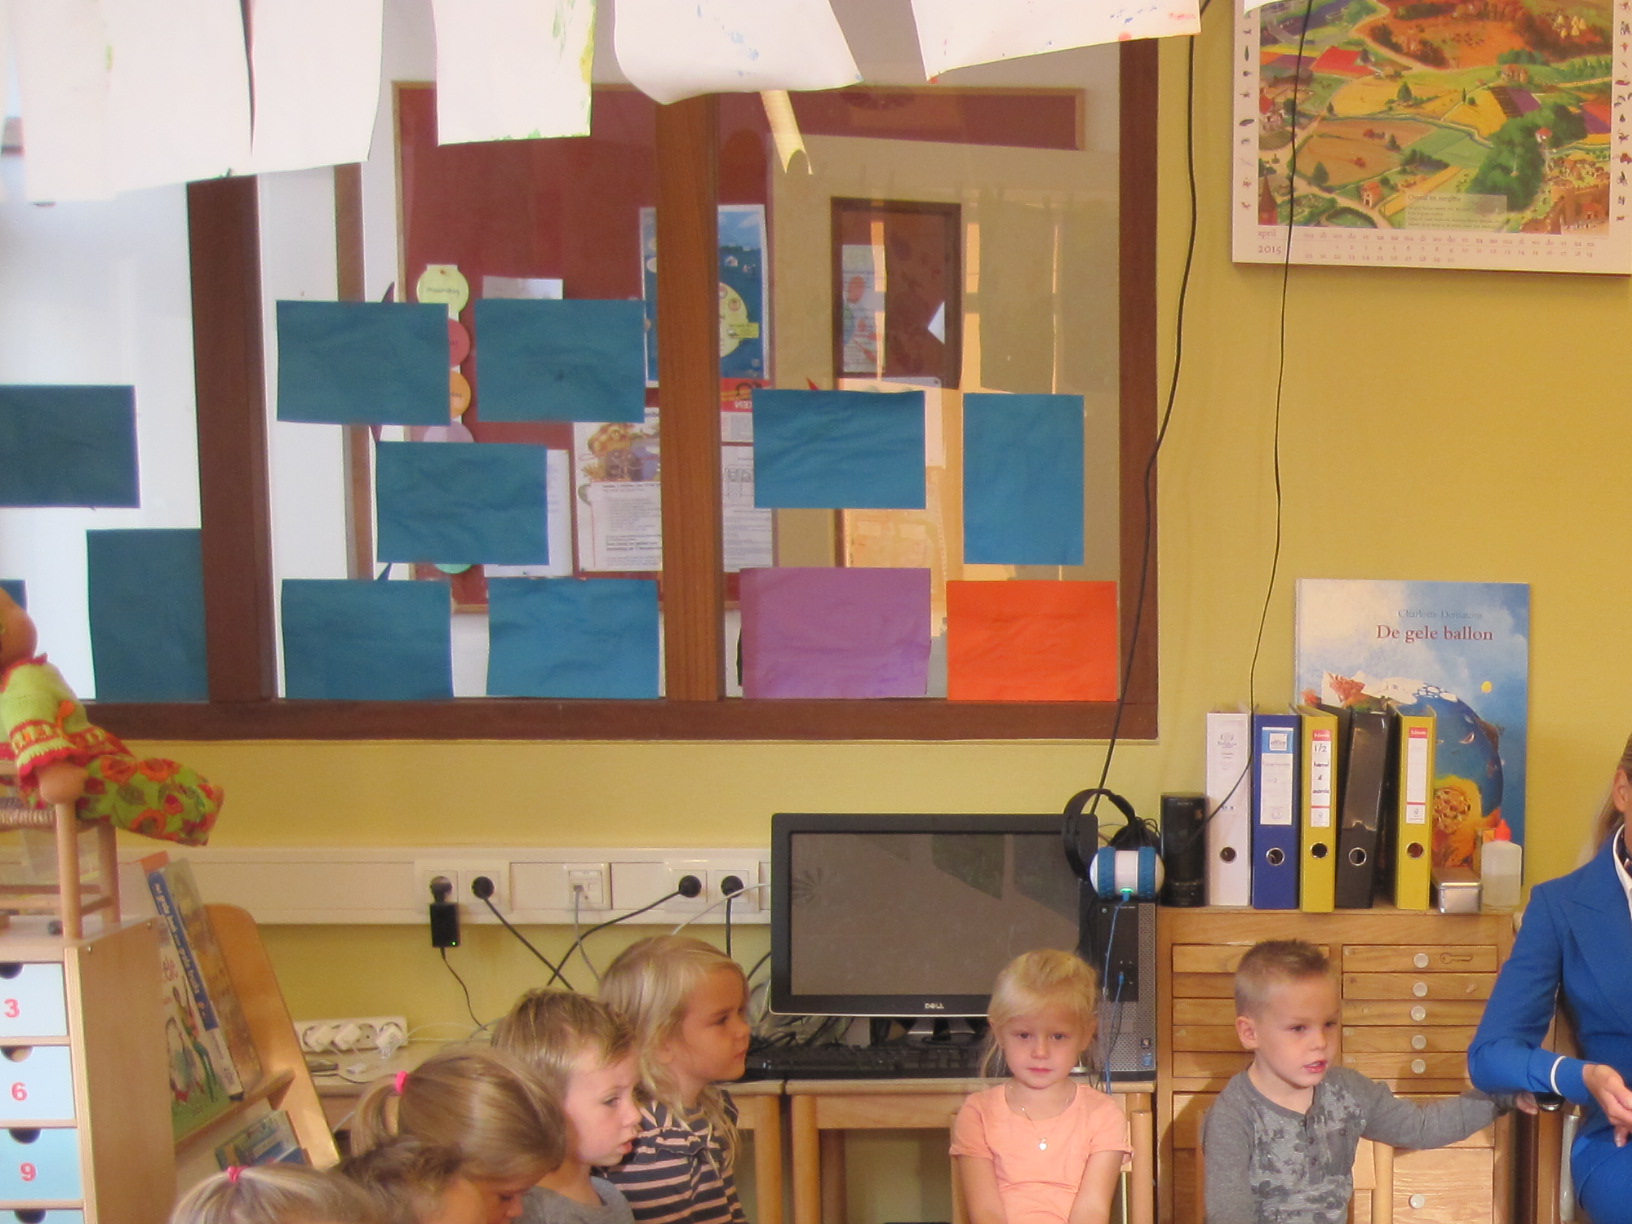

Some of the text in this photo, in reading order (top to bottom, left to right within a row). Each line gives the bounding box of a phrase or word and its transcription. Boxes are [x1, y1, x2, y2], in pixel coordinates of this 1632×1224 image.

[1376, 624, 1494, 644] De gele ballon
[4, 998, 21, 1018] 3
[11, 1082, 28, 1101] 6
[20, 1162, 37, 1182] 9
